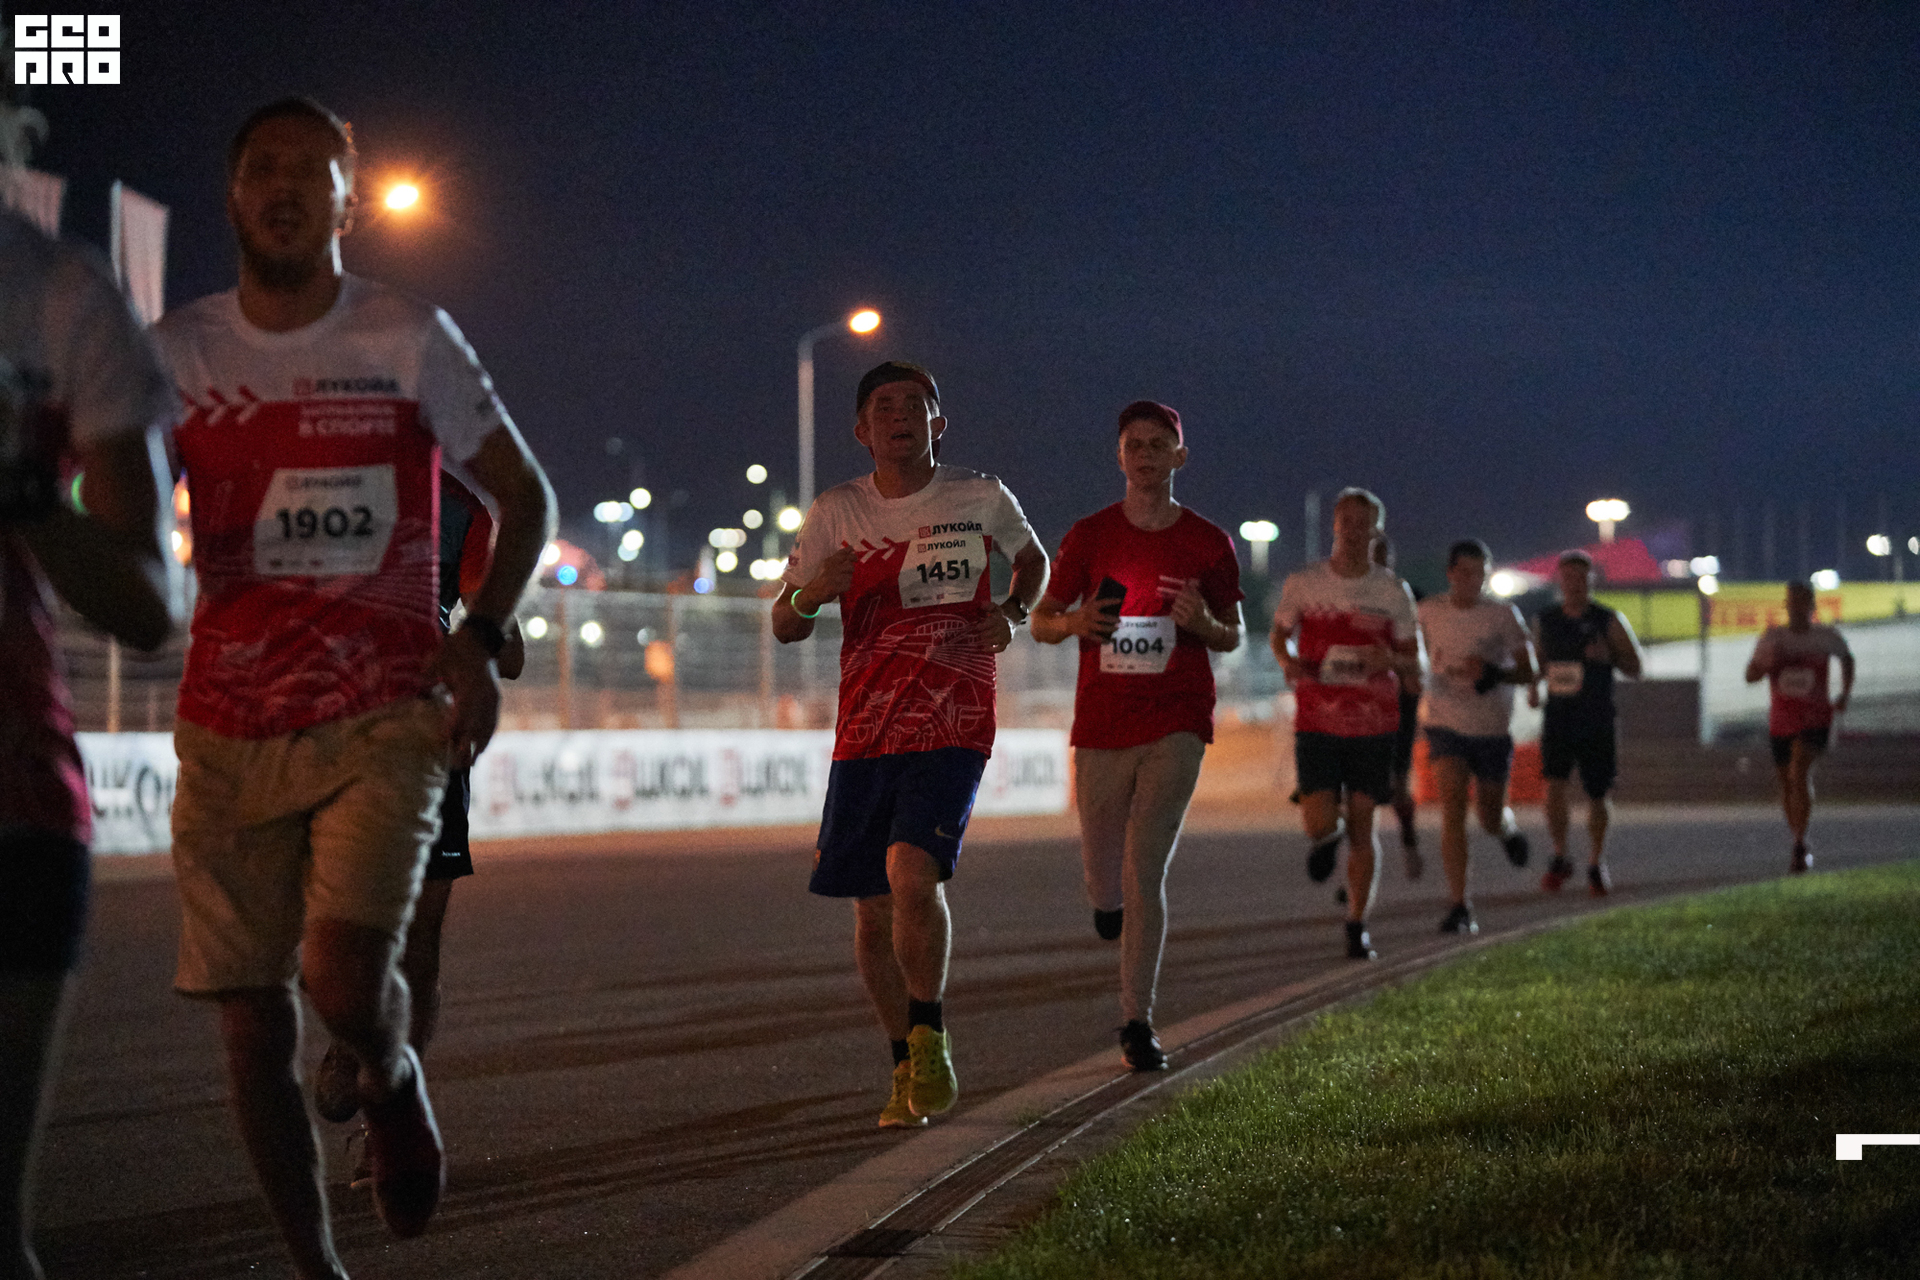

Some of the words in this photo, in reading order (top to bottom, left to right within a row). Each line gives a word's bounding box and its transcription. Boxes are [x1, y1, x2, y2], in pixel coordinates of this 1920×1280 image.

[277, 506, 373, 540] 1902
[932, 521, 983, 535] ЛУКОЙЛ
[927, 540, 966, 551] ЛУКОЙЛ
[917, 559, 970, 583] 1451
[1112, 637, 1164, 655] 1004
